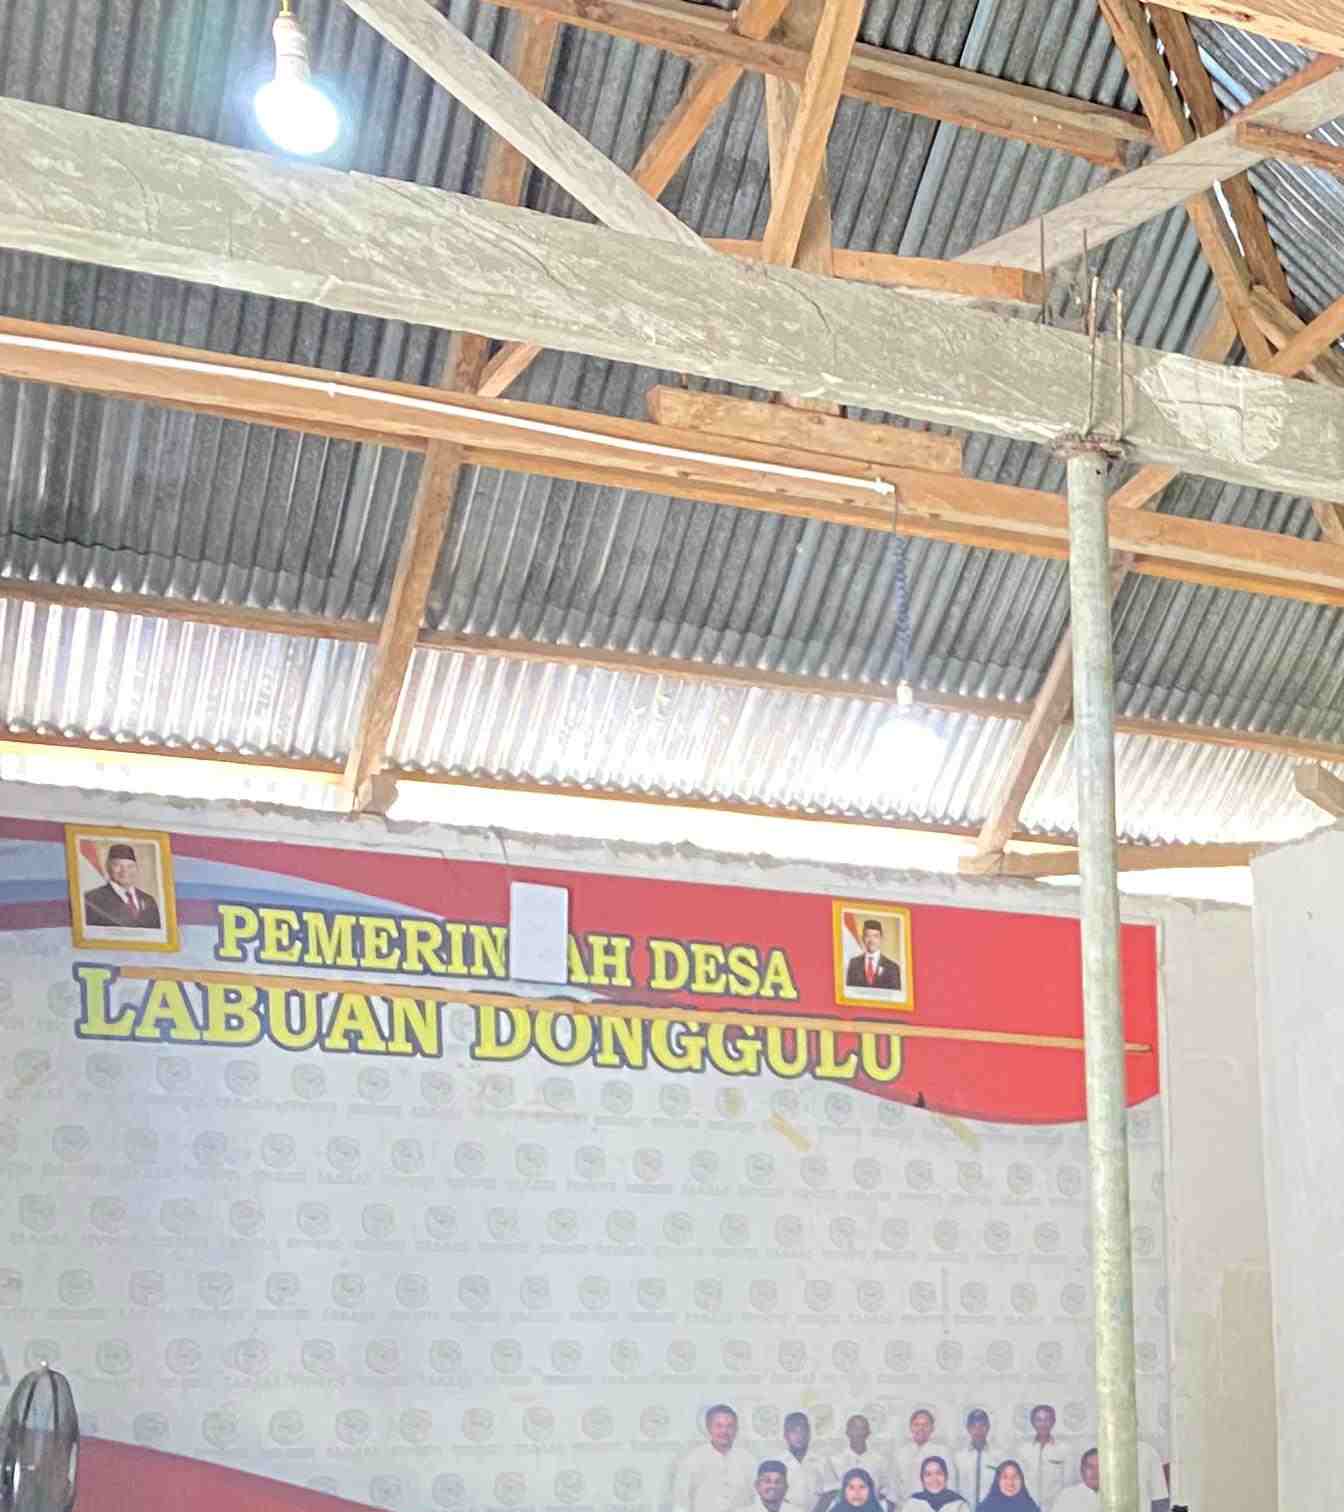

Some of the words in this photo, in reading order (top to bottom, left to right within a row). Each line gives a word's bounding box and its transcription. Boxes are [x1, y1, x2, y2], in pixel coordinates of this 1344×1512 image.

[216, 904, 633, 989] PEMERINAH
[648, 938, 799, 1001] DESA
[76, 964, 443, 1057] LABUAN
[472, 1000, 904, 1083] DONGGULU
